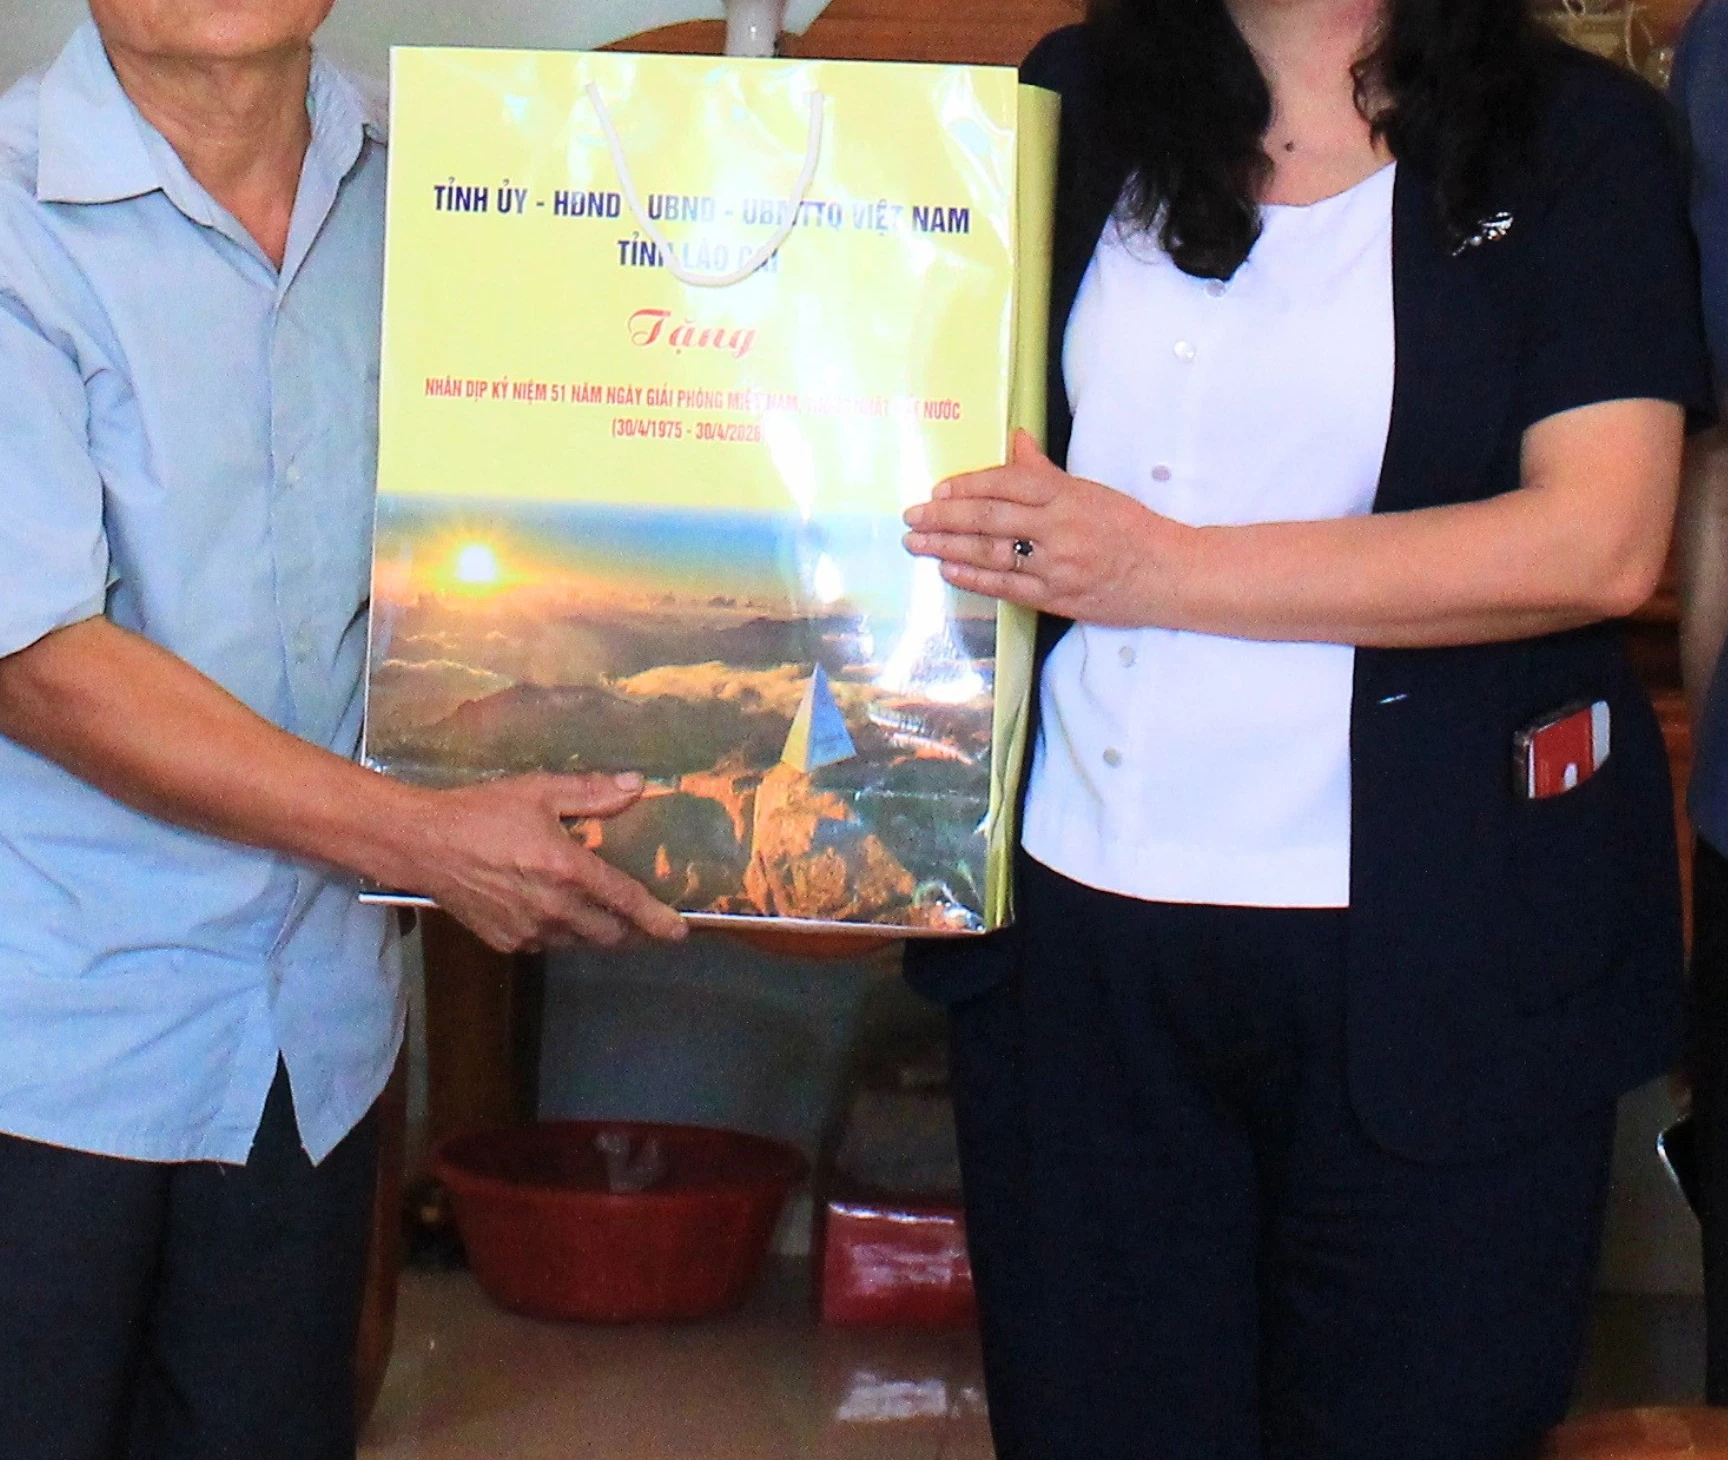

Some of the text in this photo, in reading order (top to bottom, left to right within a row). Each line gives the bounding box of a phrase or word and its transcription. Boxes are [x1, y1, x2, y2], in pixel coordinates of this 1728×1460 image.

[434, 176, 489, 213] TỈNH
[497, 178, 529, 215] ỦY
[553, 190, 622, 219] HĐND
[648, 193, 716, 223] UBND
[911, 205, 971, 235] NAM
[627, 308, 757, 360] Tặng
[425, 375, 462, 398] NHÂN
[466, 380, 489, 403] DỊP
[512, 379, 548, 405] NIỆM
[551, 383, 566, 402] 51
[571, 382, 602, 405] NĂM
[606, 383, 643, 407] NGÀY
[676, 386, 724, 410] PHÓNG
[923, 398, 961, 421] NƯỚC
[612, 417, 683, 439] (30/4/1975
